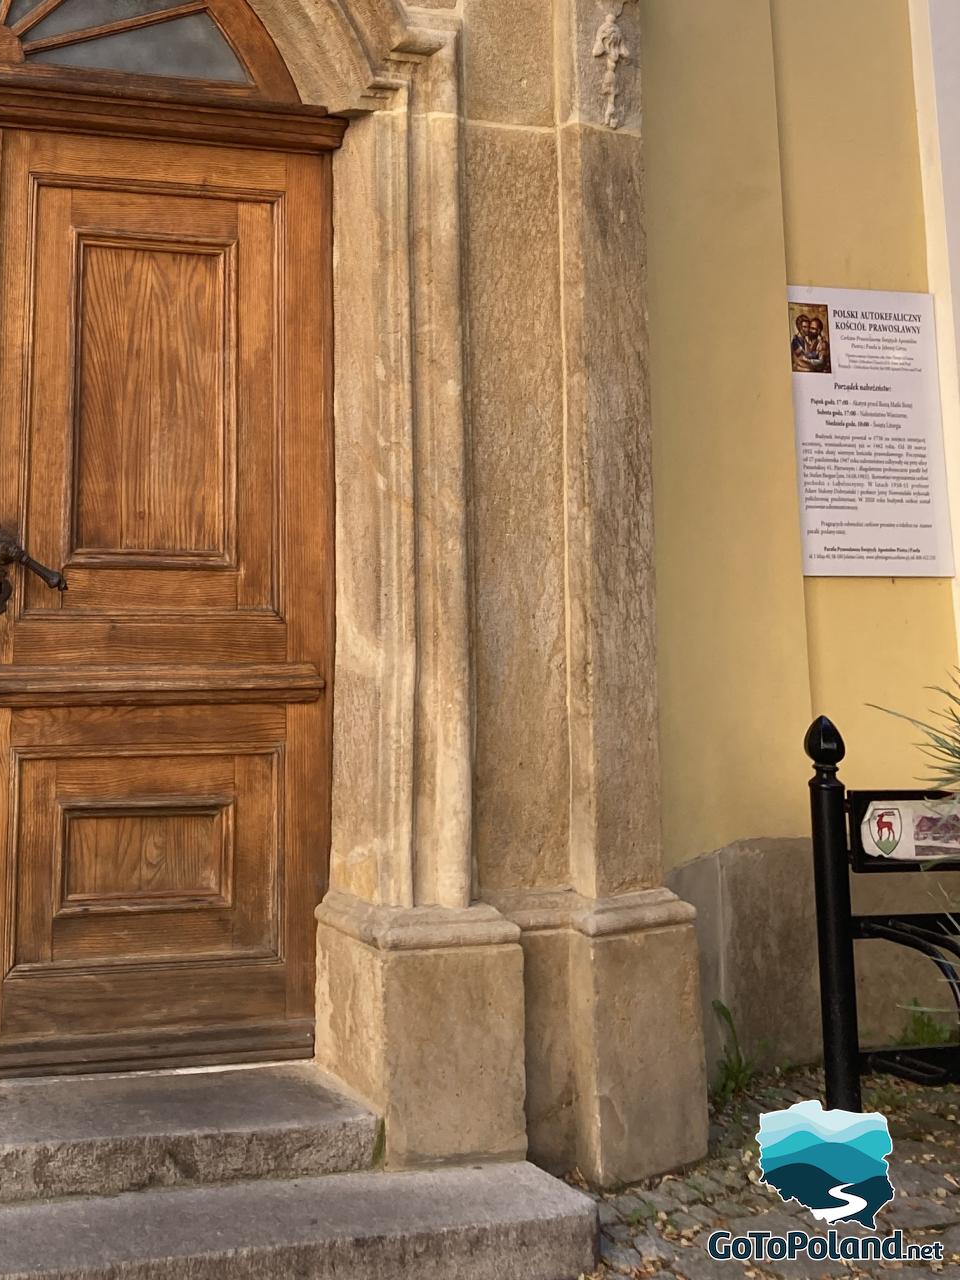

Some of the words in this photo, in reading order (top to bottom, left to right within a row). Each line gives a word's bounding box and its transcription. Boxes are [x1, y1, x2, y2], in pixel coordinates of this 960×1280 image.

[833, 310, 858, 319] POLSKI
[861, 311, 922, 322] AUTOKEFALICZNY
[835, 321, 866, 331] KOŚCIÓŁ
[868, 323, 921, 334] PRAWOSŁAWNY
[834, 382, 858, 391] Porządek
